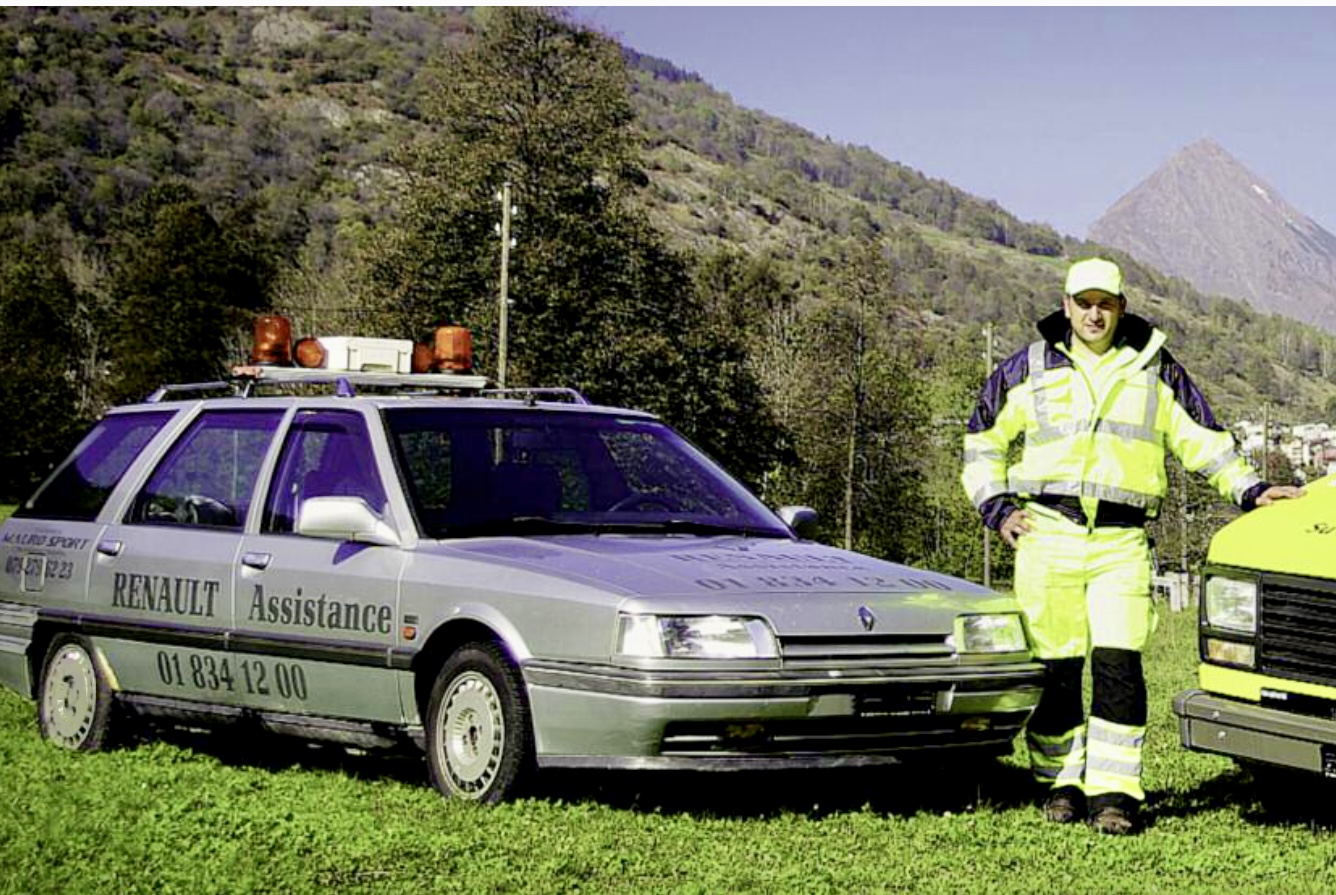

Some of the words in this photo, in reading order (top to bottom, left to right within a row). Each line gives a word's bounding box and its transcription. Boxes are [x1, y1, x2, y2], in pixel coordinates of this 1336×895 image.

[111, 572, 220, 618] RENAULT
[248, 583, 393, 635] Assistance
[157, 651, 185, 686] 01
[190, 654, 235, 691] 834
[240, 659, 270, 696] 12
[274, 661, 308, 700] 00
